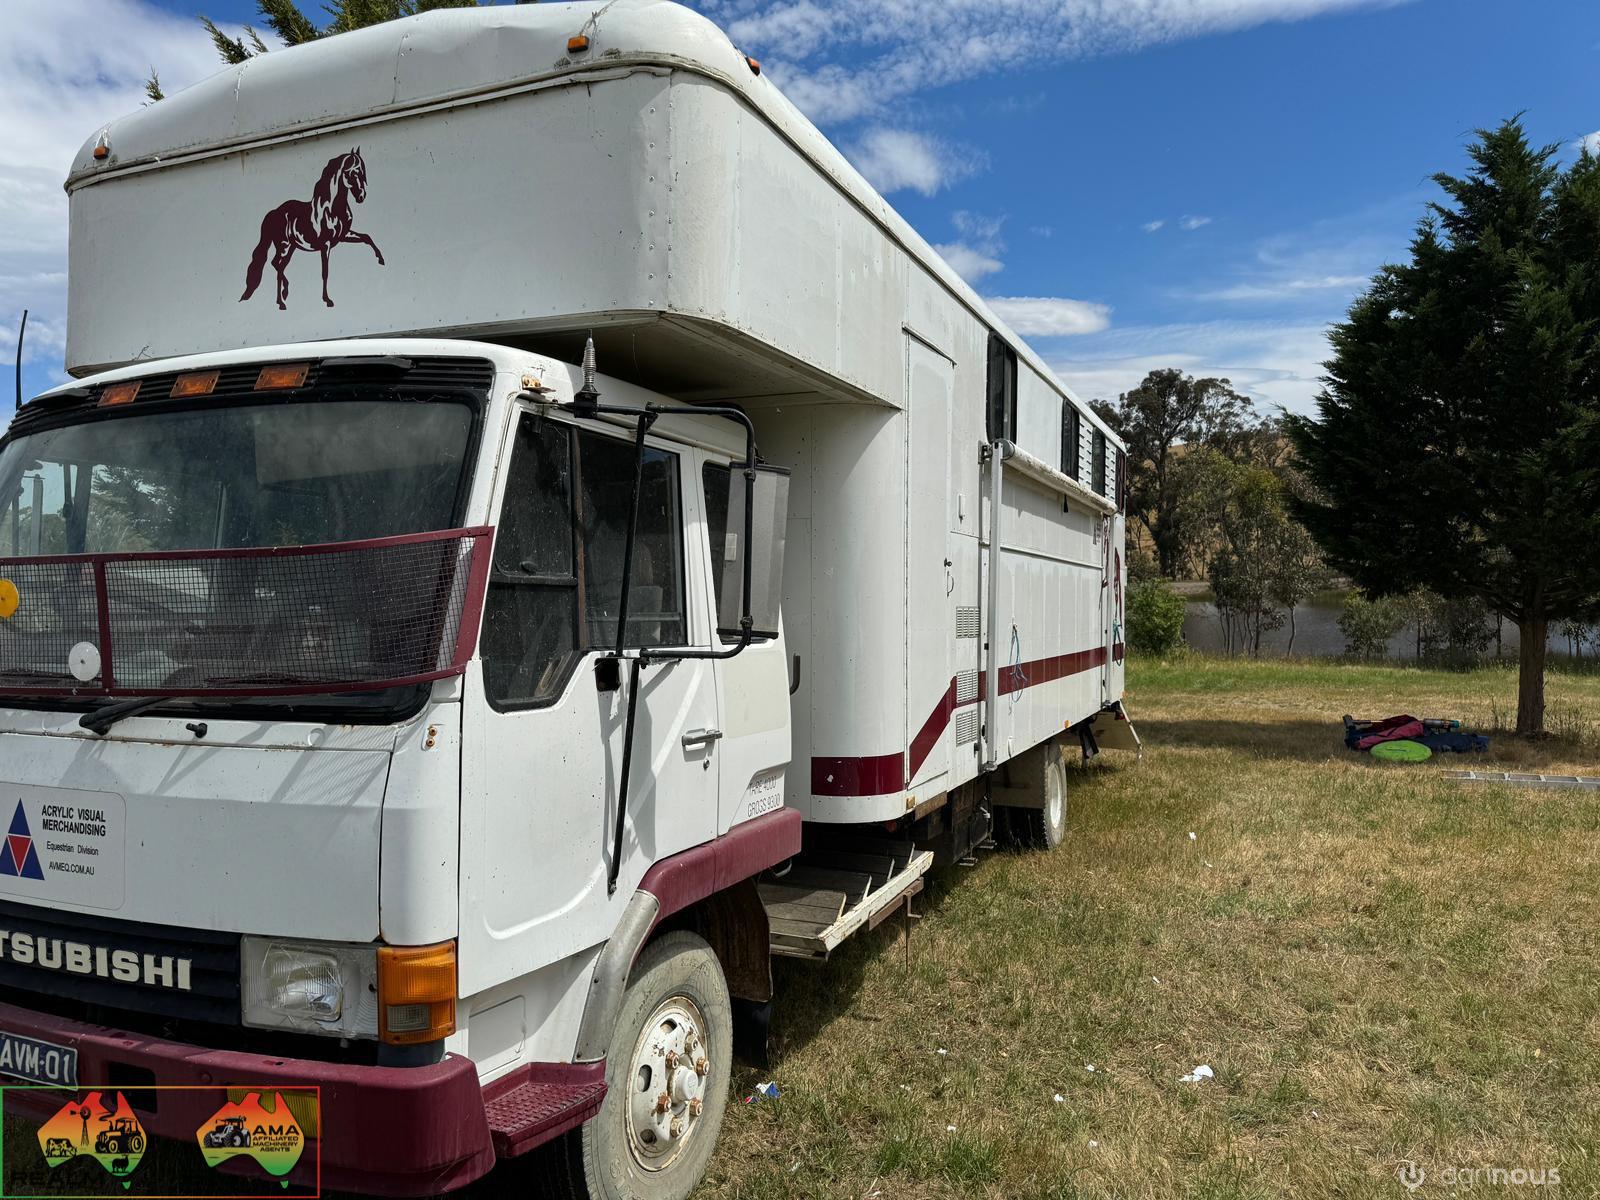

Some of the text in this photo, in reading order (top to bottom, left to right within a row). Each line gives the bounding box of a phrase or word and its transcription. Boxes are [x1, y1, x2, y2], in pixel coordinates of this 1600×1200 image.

[41, 804, 106, 823] ACRYLIC VISUAL
[747, 797, 767, 818] GROSS
[42, 818, 106, 837] MERCHANDISING
[46, 840, 99, 857] Equestrian Division
[48, 861, 95, 876] AVMEQ.COM.AU
